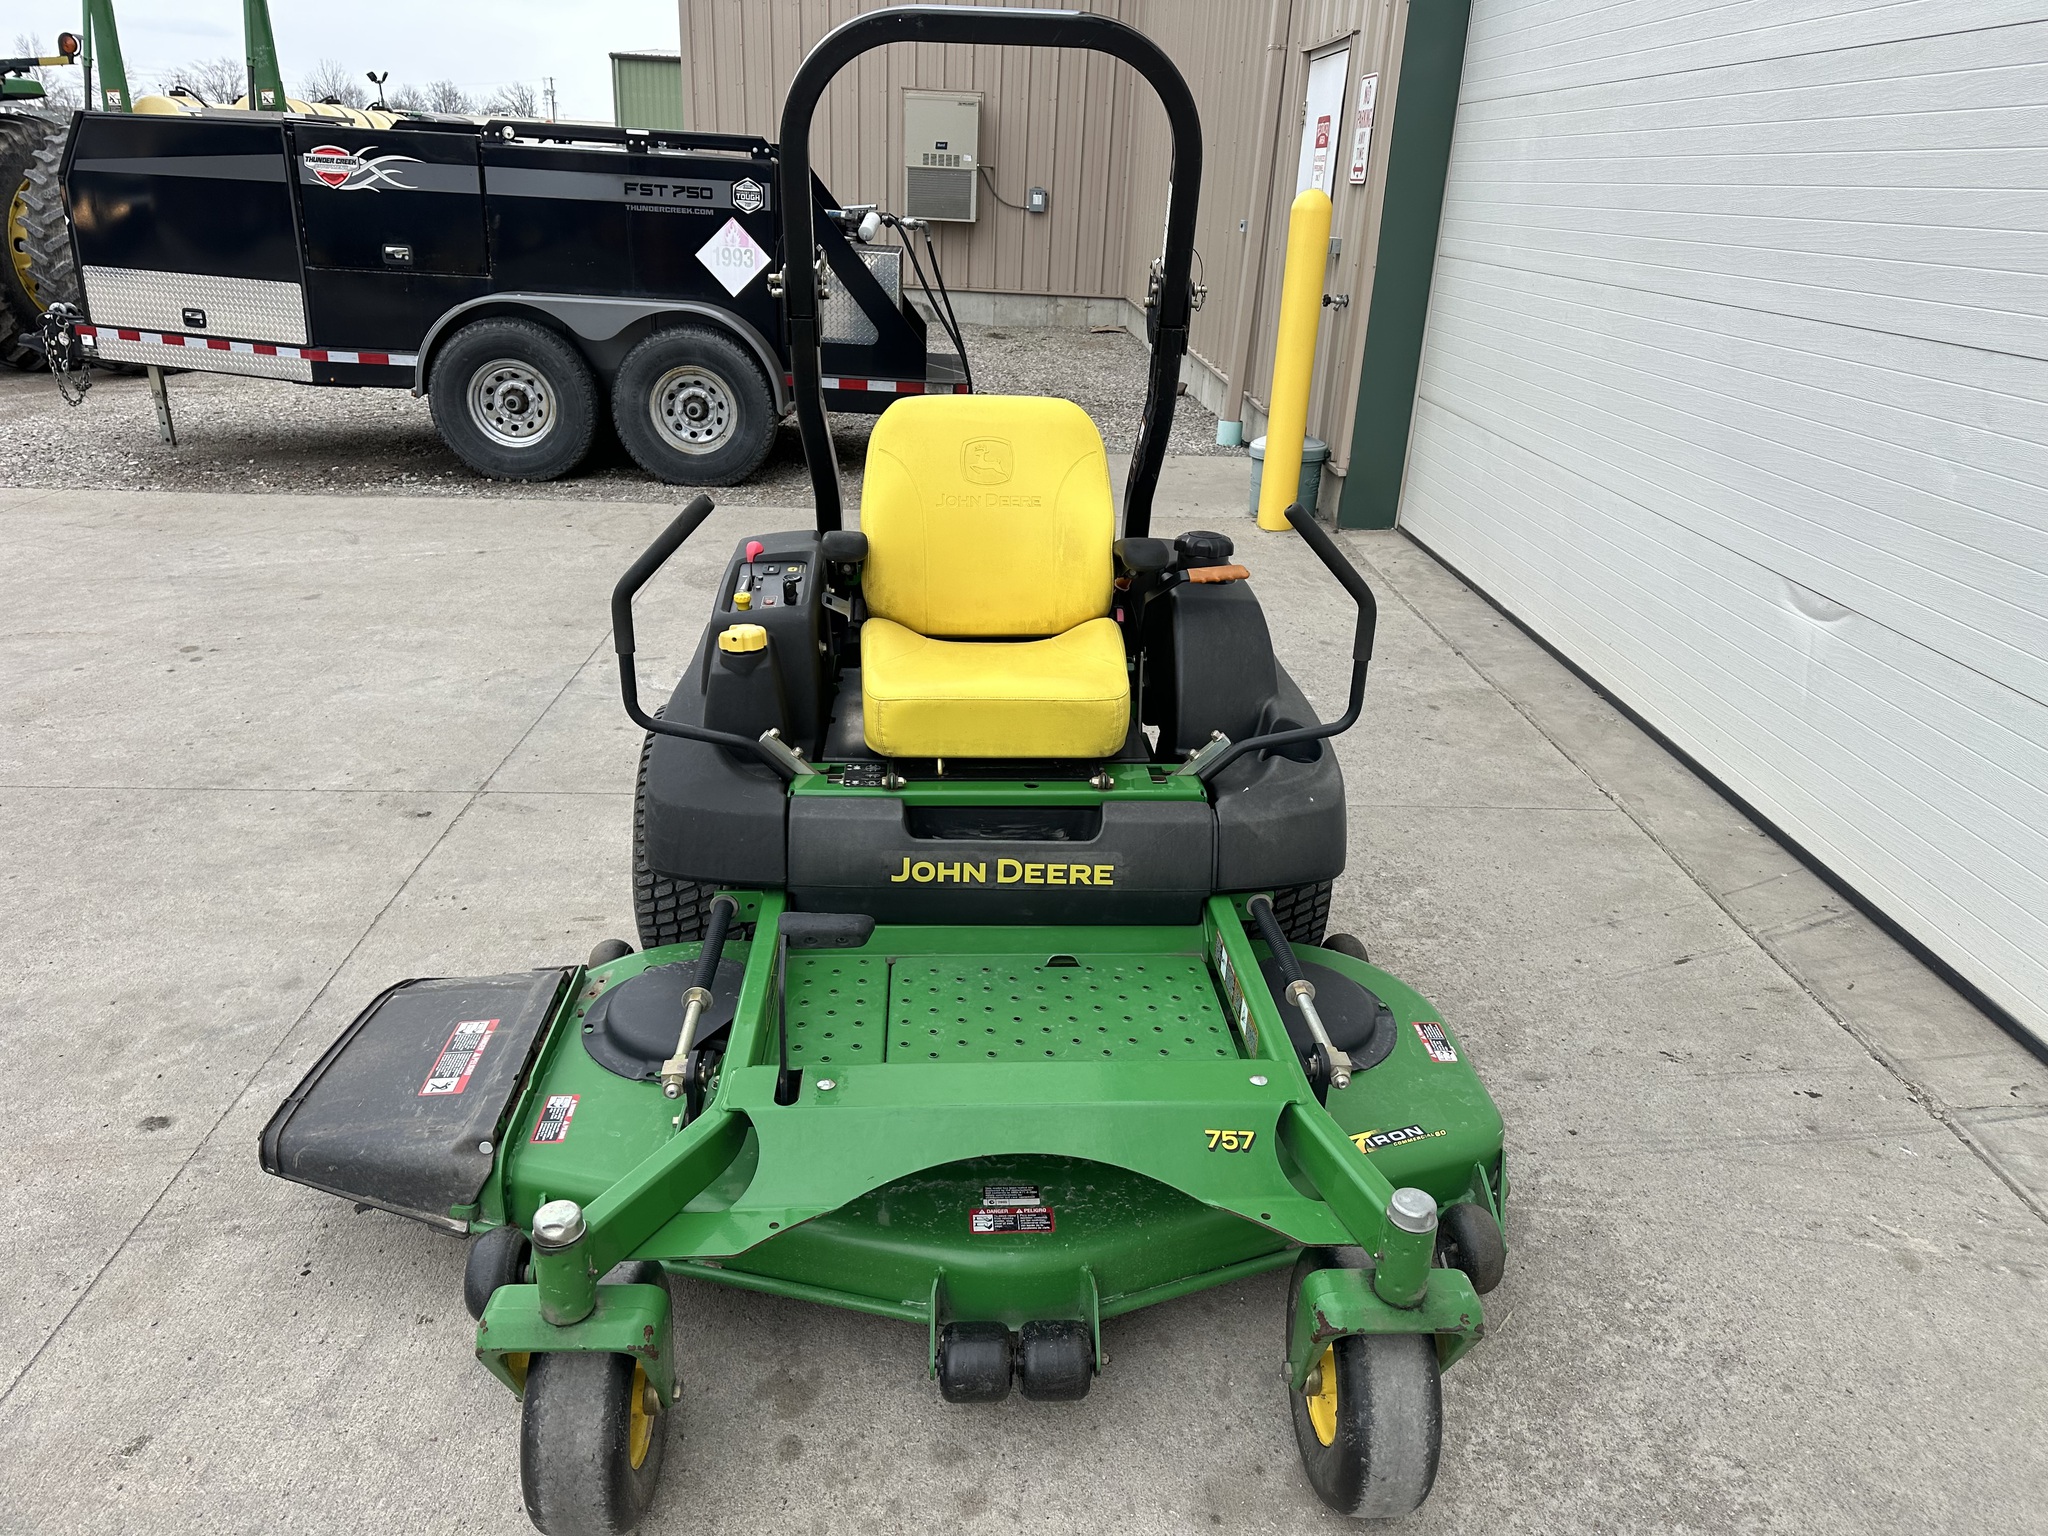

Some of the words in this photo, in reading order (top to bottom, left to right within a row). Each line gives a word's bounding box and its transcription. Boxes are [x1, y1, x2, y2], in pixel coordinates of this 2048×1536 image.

[305, 156, 334, 164] THUNDER
[624, 182, 668, 197] FST
[671, 185, 713, 199] 750
[736, 193, 761, 201] TOUGH
[625, 204, 714, 216] THUNDERCREEK.COM
[713, 247, 753, 268] 1993
[936, 493, 981, 508] JOHN
[985, 493, 1042, 508] DEERE
[890, 857, 987, 883] JOHN
[997, 858, 1115, 885] DEERE
[1204, 1129, 1256, 1152] 757
[1393, 1132, 1435, 1147] COMMERCIAL
